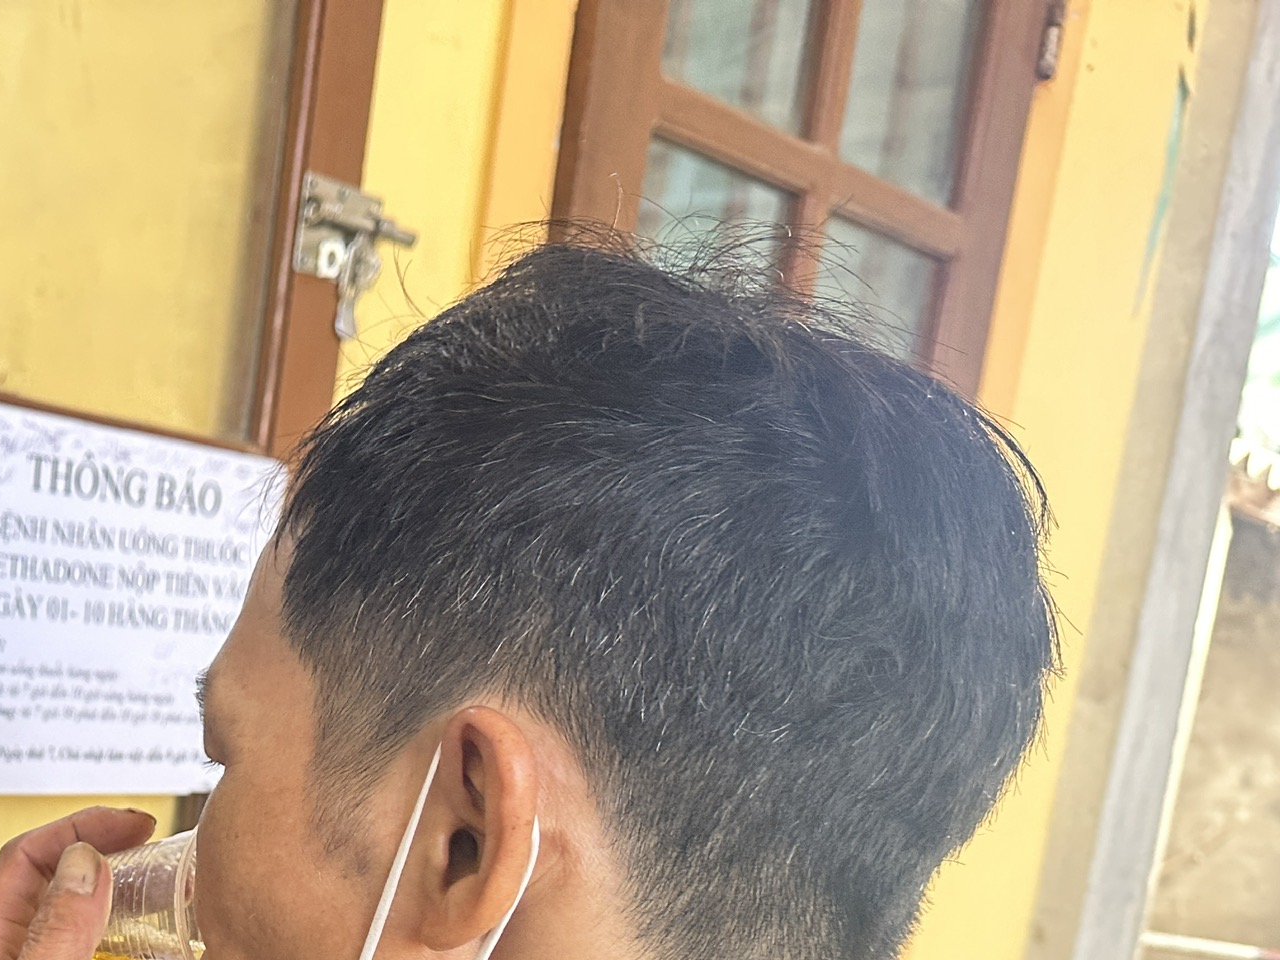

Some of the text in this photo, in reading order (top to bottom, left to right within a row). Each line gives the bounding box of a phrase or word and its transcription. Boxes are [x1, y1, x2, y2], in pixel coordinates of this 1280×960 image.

[26, 450, 222, 519] THÔNG BÁO
[52, 517, 115, 550] NHÂN
[119, 525, 179, 560] UỐNG
[182, 534, 248, 569] THUỐC
[118, 560, 161, 596] NỘP
[107, 597, 169, 632] HÀNG
